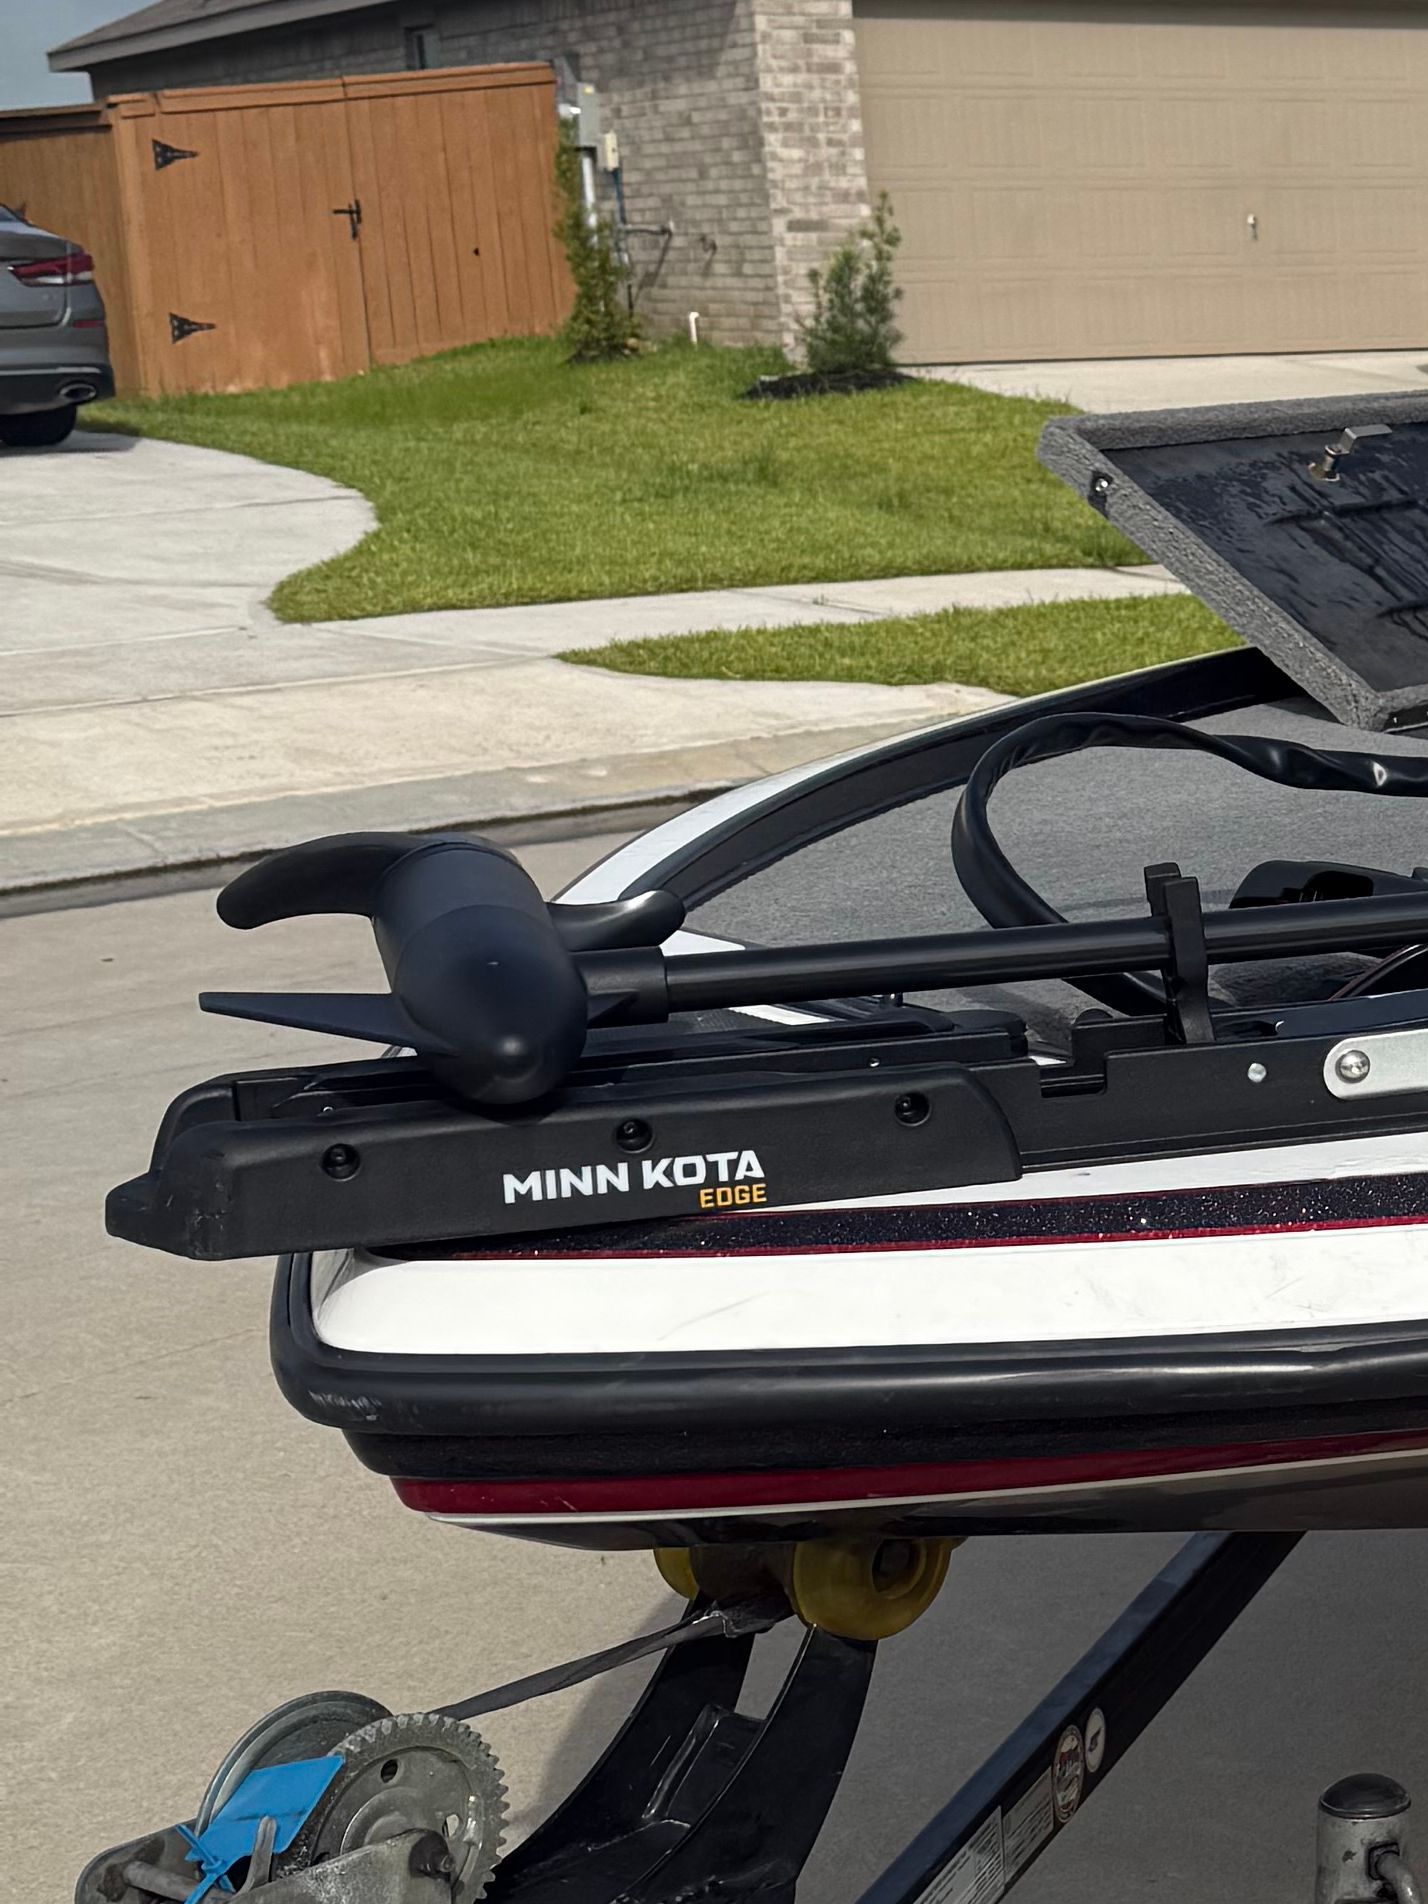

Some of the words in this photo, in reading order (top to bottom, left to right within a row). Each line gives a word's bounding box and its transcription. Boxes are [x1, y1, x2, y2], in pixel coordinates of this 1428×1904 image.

[502, 1161, 630, 1204] MINN
[641, 1149, 766, 1190] KOTA
[699, 1183, 767, 1209] EDGE
